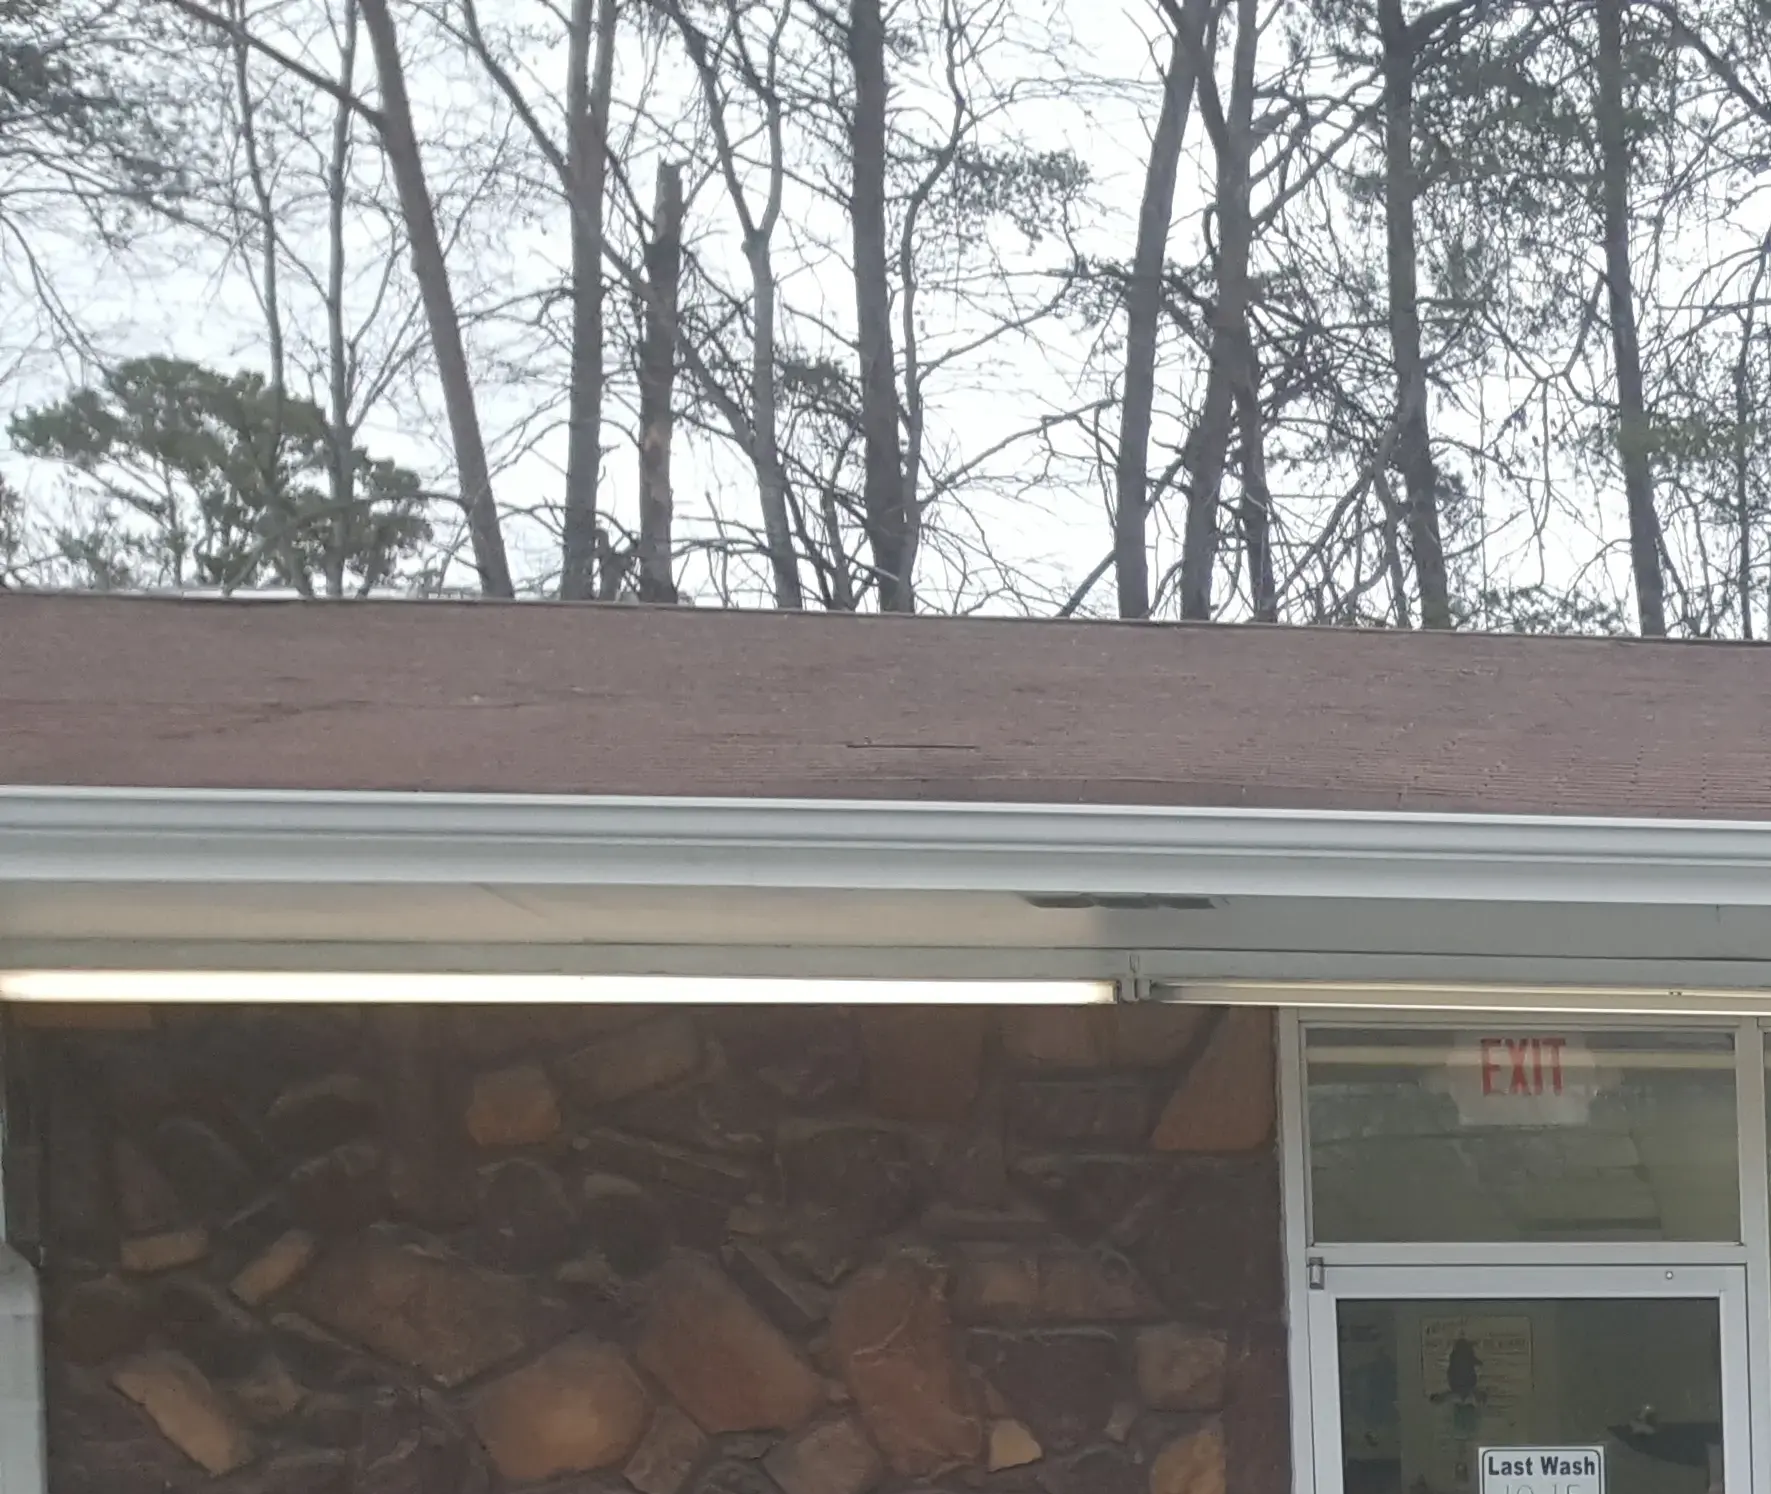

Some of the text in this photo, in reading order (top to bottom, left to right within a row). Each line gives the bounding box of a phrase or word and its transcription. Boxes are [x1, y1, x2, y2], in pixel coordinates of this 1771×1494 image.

[1481, 1037, 1566, 1097] EXIT
[1488, 1456, 1595, 1476] Last Wash
